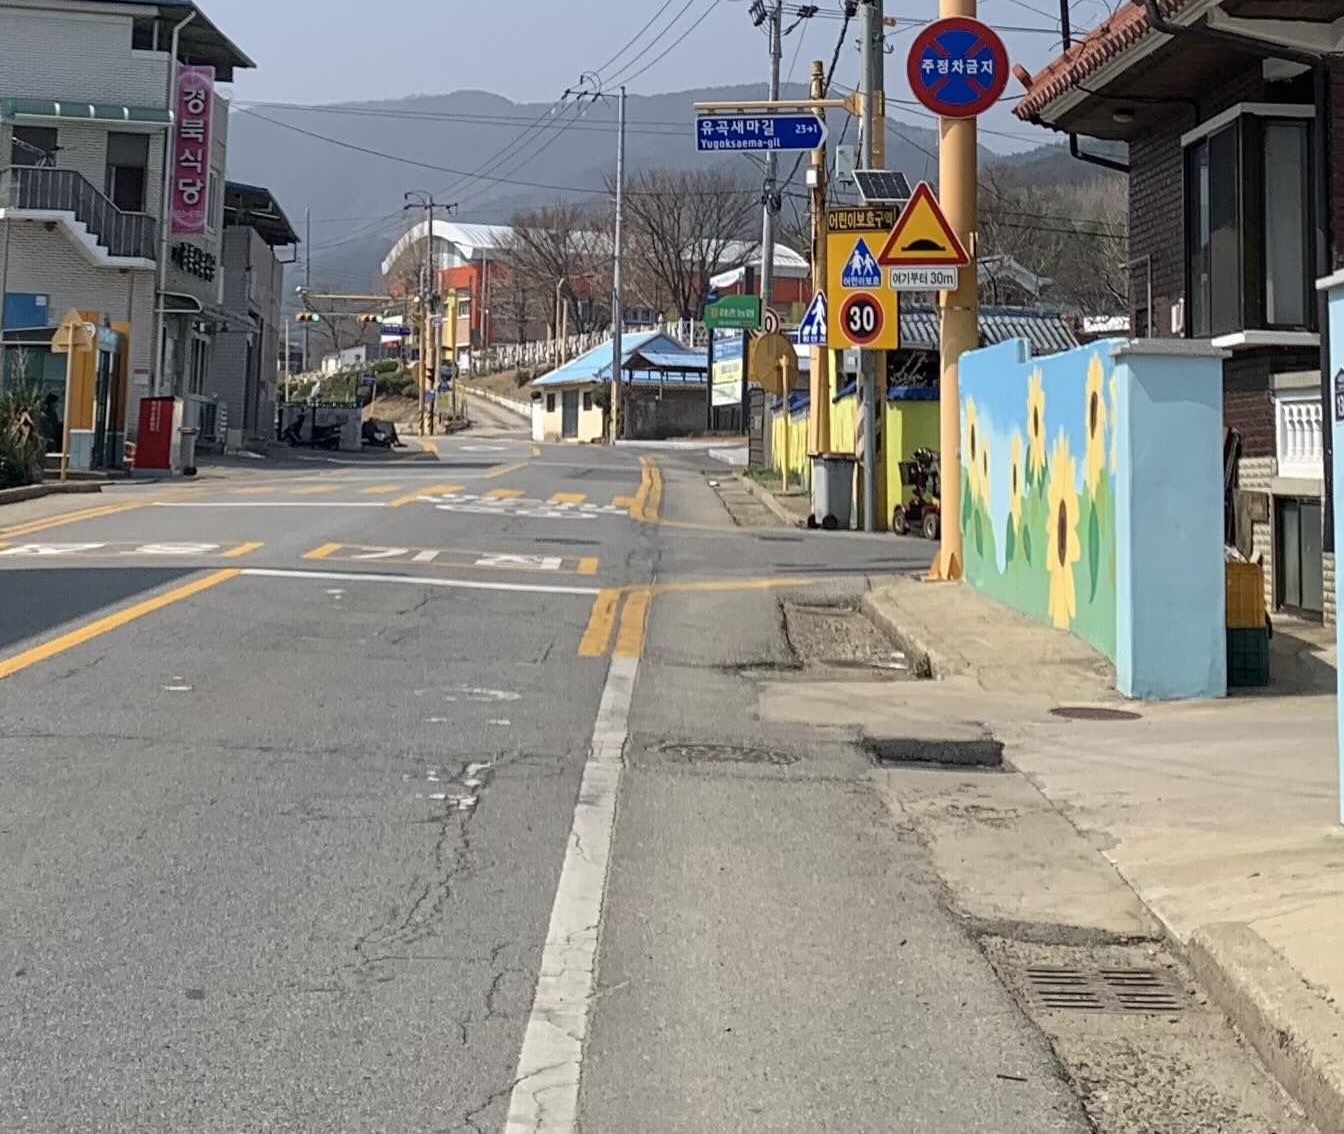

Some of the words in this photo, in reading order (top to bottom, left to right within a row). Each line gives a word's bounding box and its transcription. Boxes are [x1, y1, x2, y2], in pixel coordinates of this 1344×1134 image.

[921, 58, 994, 76] 주정차금지
[700, 120, 775, 136] 유곡새마길
[178, 89, 206, 204] 경북식당
[701, 138, 781, 150] Yugoksaema-gil
[930, 273, 954, 285] 30m
[849, 306, 875, 332] 30
